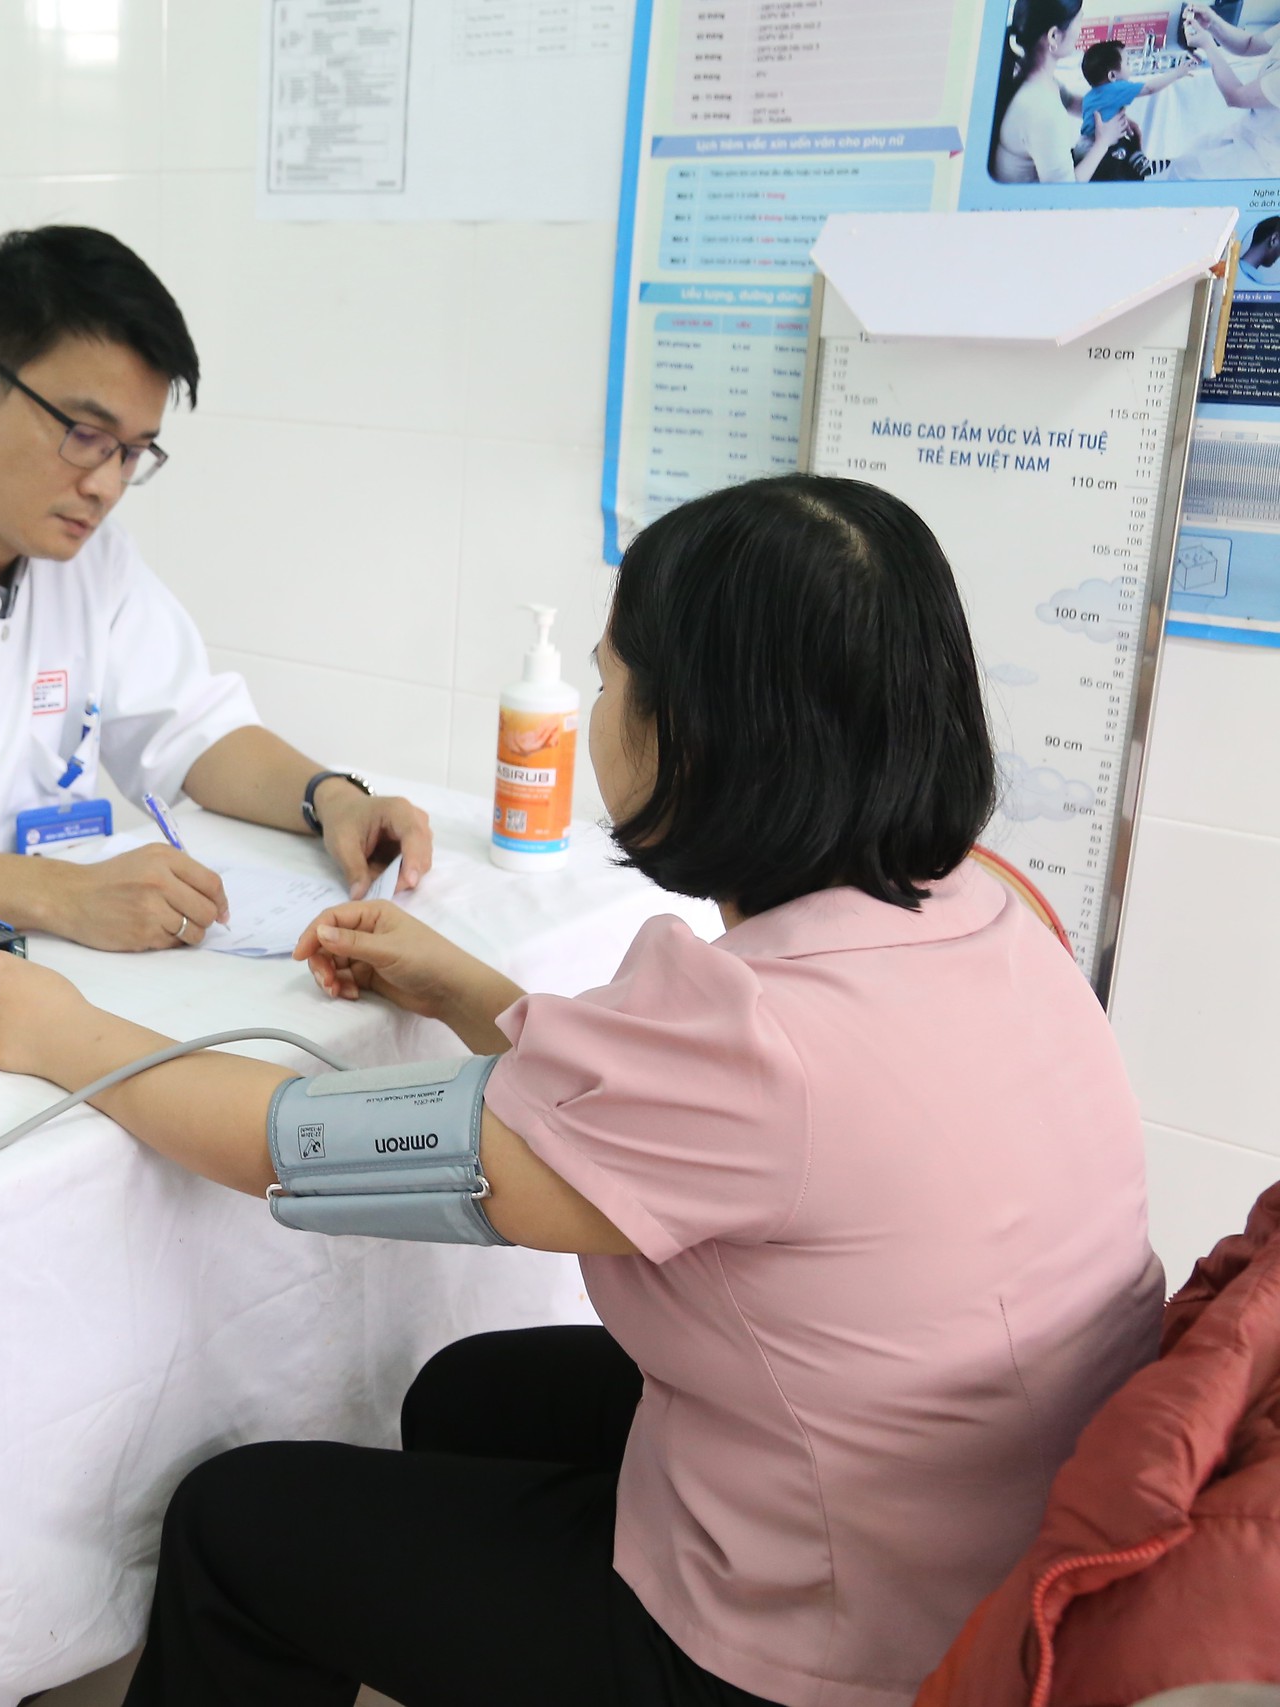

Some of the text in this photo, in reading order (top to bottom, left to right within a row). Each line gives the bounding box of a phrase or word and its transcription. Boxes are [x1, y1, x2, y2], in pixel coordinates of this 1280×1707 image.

[839, 136, 860, 148] cho
[1254, 189, 1275, 198] Nghe
[1088, 347, 1135, 360] 120 cm
[1151, 356, 1167, 365] 119
[1149, 370, 1165, 379] 118
[1147, 385, 1163, 393] 117
[863, 395, 878, 404] cm
[1145, 399, 1161, 407] 116
[1110, 408, 1150, 420] 115 cm
[1141, 428, 1157, 436] 114
[917, 423, 946, 439] CAO
[987, 424, 1017, 444] VÓC
[1023, 426, 1041, 446] VÀ
[1048, 428, 1074, 448] TRÍ
[1079, 430, 1108, 455] TUỆ
[1140, 442, 1155, 450] 113
[950, 450, 971, 466] EM
[977, 449, 1010, 472] VIỆT
[1014, 455, 1050, 472] NAM
[1138, 456, 1153, 464] 112
[847, 458, 887, 471] 110 cm
[1136, 470, 1151, 478] 111
[1072, 476, 1117, 490] 110 cm
[1132, 496, 1148, 504] 109
[1130, 510, 1146, 518] 108
[1128, 523, 1144, 532] 107
[1127, 537, 1142, 545] 106
[1092, 544, 1131, 557] 105 cm
[1123, 563, 1138, 571] 104
[1121, 576, 1137, 585] 103
[1119, 590, 1135, 598] 102
[1118, 603, 1133, 611] 101
[1055, 607, 1100, 623] 100 cm
[1118, 631, 1129, 639] 99
[1116, 644, 1127, 652] 98
[1115, 657, 1125, 665] 97
[1113, 670, 1123, 679] 96
[1080, 677, 1113, 690] 95 cm
[1109, 696, 1120, 704] 94
[1108, 708, 1118, 716] 93
[1106, 721, 1117, 729] 92
[1104, 734, 1114, 742] 91
[1045, 736, 1083, 751] 90 cm
[1100, 761, 1111, 769] 89
[1097, 786, 1108, 794] 87
[1095, 799, 1106, 807] 86
[1063, 802, 1096, 816] 85 cm
[1092, 823, 1102, 831] 84
[1090, 836, 1101, 844] 83
[1088, 848, 1099, 856] 82
[1029, 858, 1066, 875] 80 cm
[1087, 860, 1097, 868] 81
[1084, 885, 1094, 893] 79
[375, 1133, 439, 1154] OMRON
